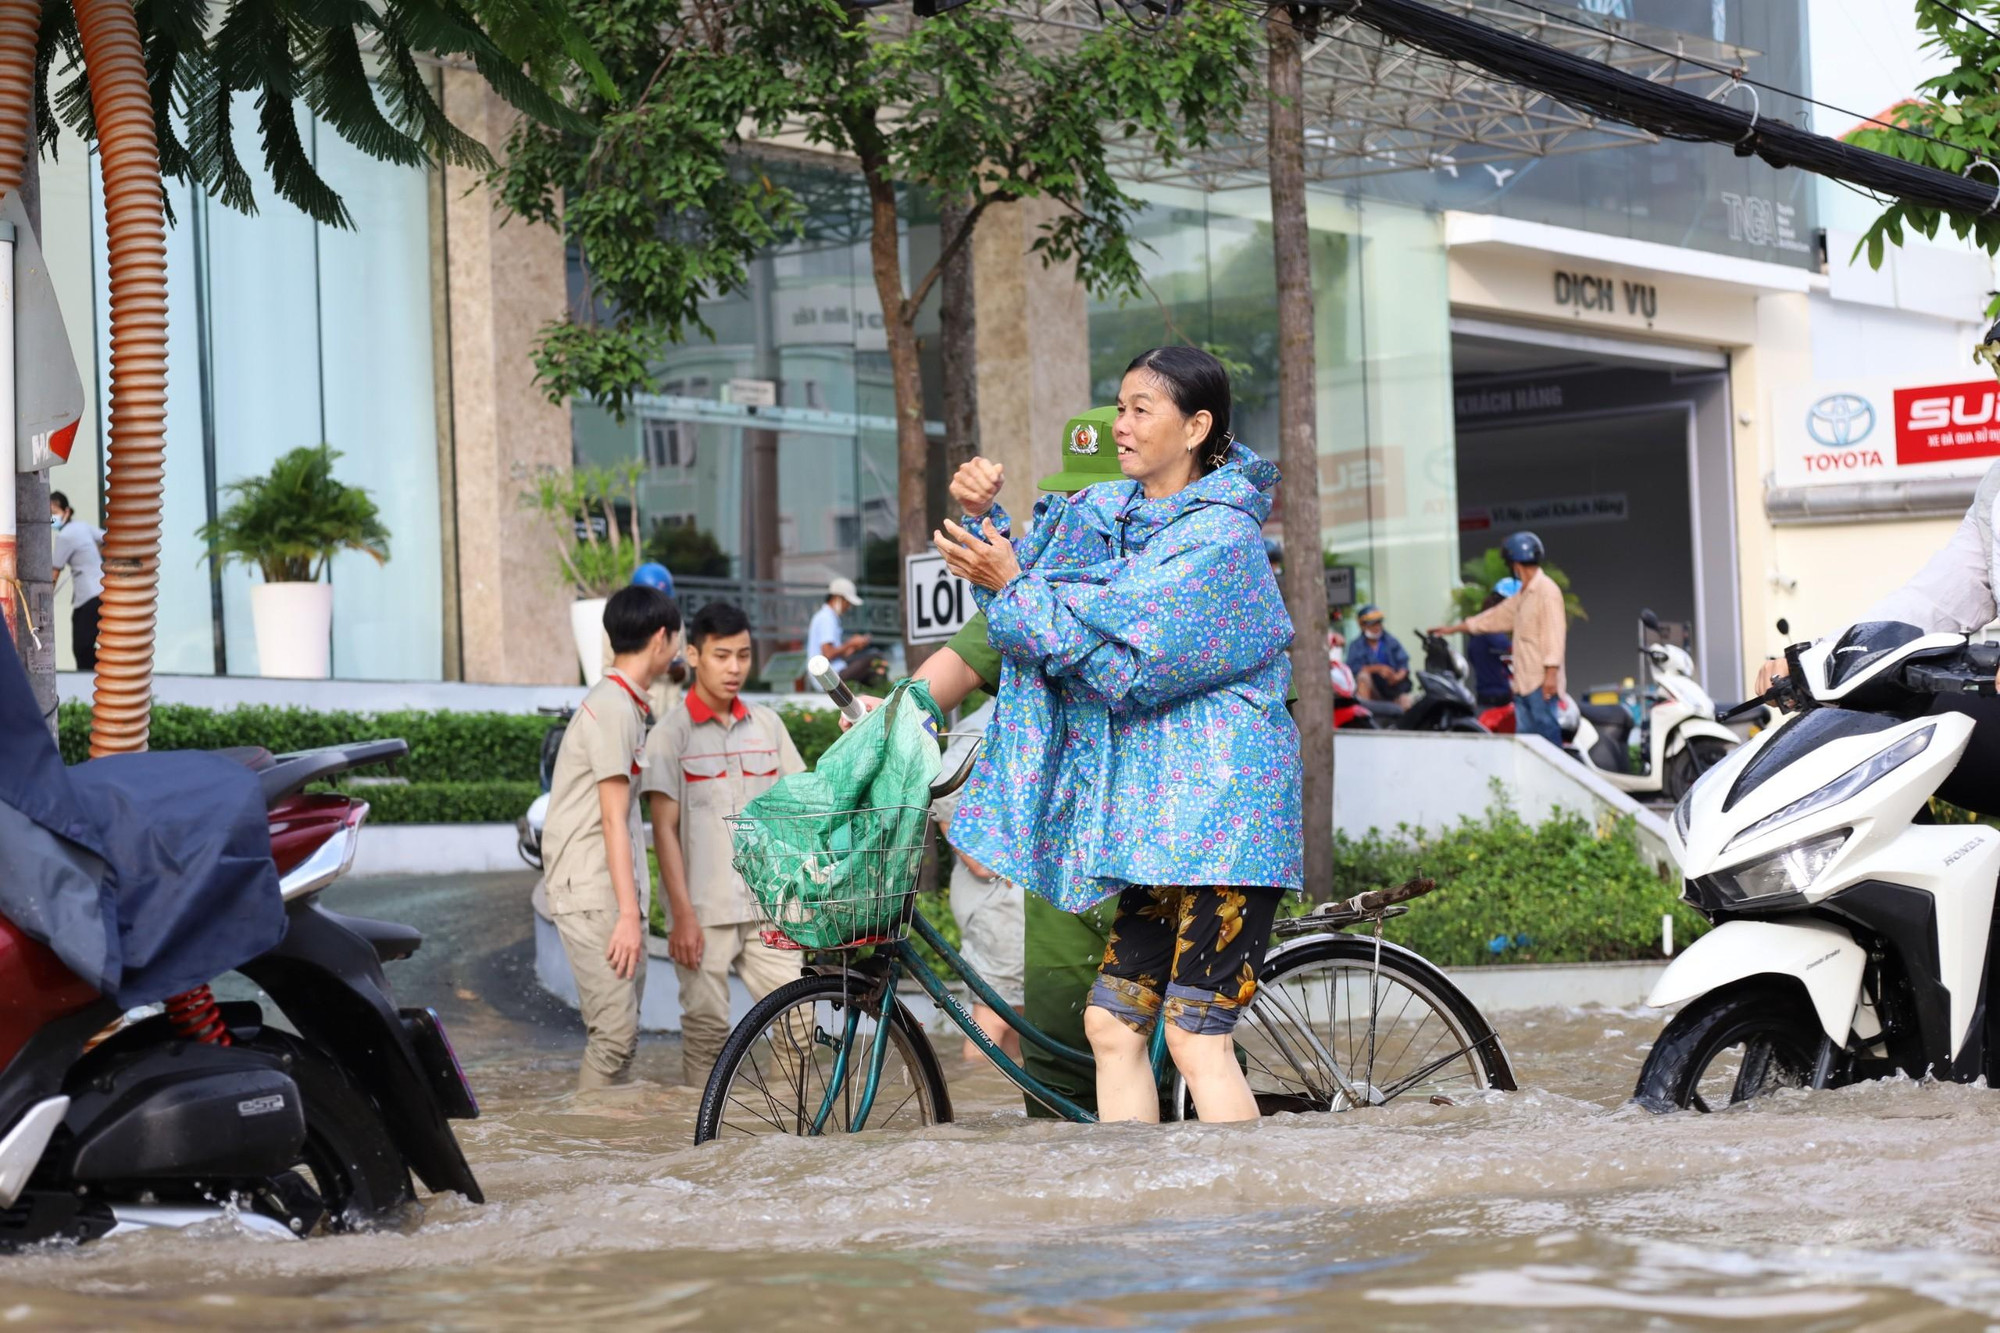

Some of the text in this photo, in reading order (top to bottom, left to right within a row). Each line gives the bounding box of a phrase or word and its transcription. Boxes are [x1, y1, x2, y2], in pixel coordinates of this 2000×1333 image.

[1554, 270, 1657, 329] DỊCH VỤ
[1907, 392, 2000, 431] SU
[1927, 434, 1940, 447] XE
[1954, 431, 1975, 445] QUA
[1803, 451, 1884, 472] TOYOTA
[1943, 836, 1985, 867] HONDA
[946, 993, 995, 1049] MORISHIMA
